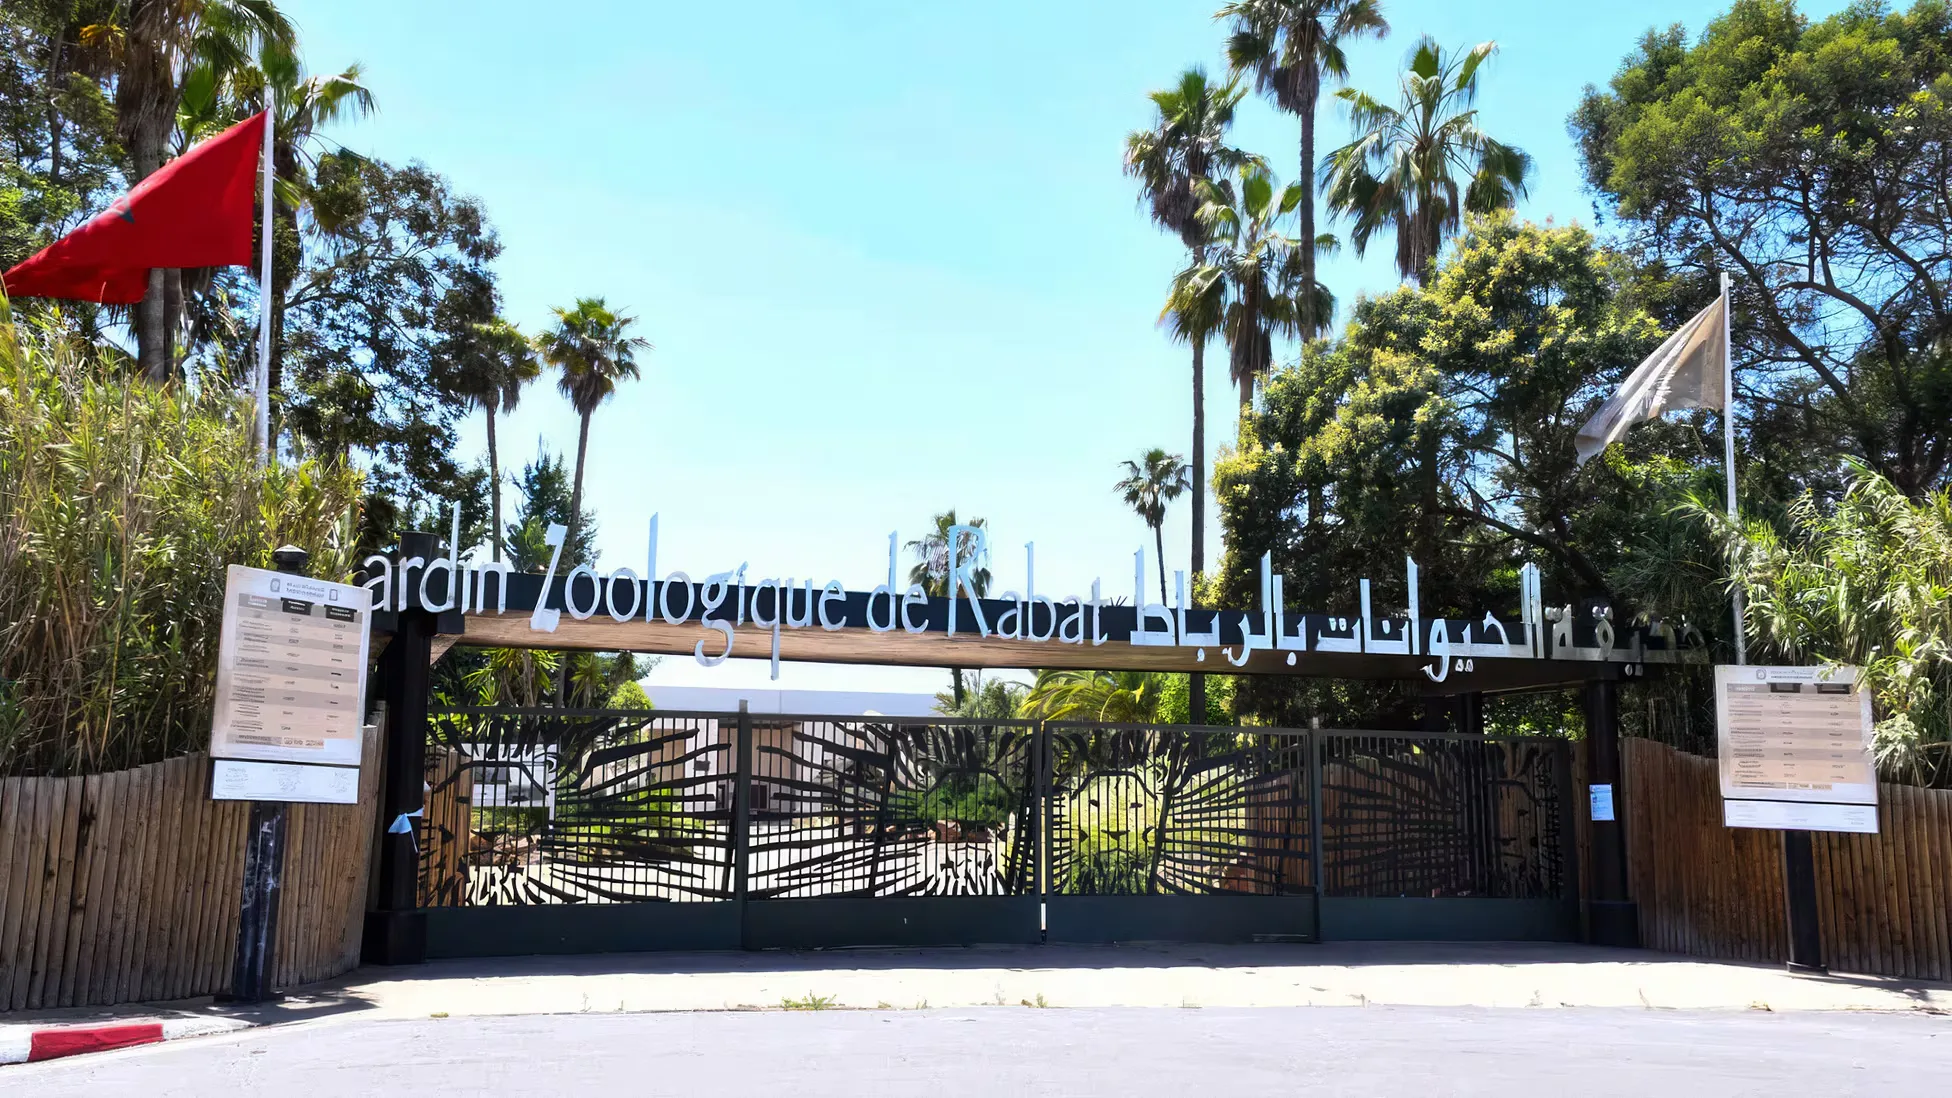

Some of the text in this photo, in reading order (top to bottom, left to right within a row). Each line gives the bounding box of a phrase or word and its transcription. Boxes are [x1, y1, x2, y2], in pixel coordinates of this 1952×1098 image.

[363, 500, 1109, 680] ardin Zoologique de Rabat
[1130, 545, 1307, 667] بالرباط
